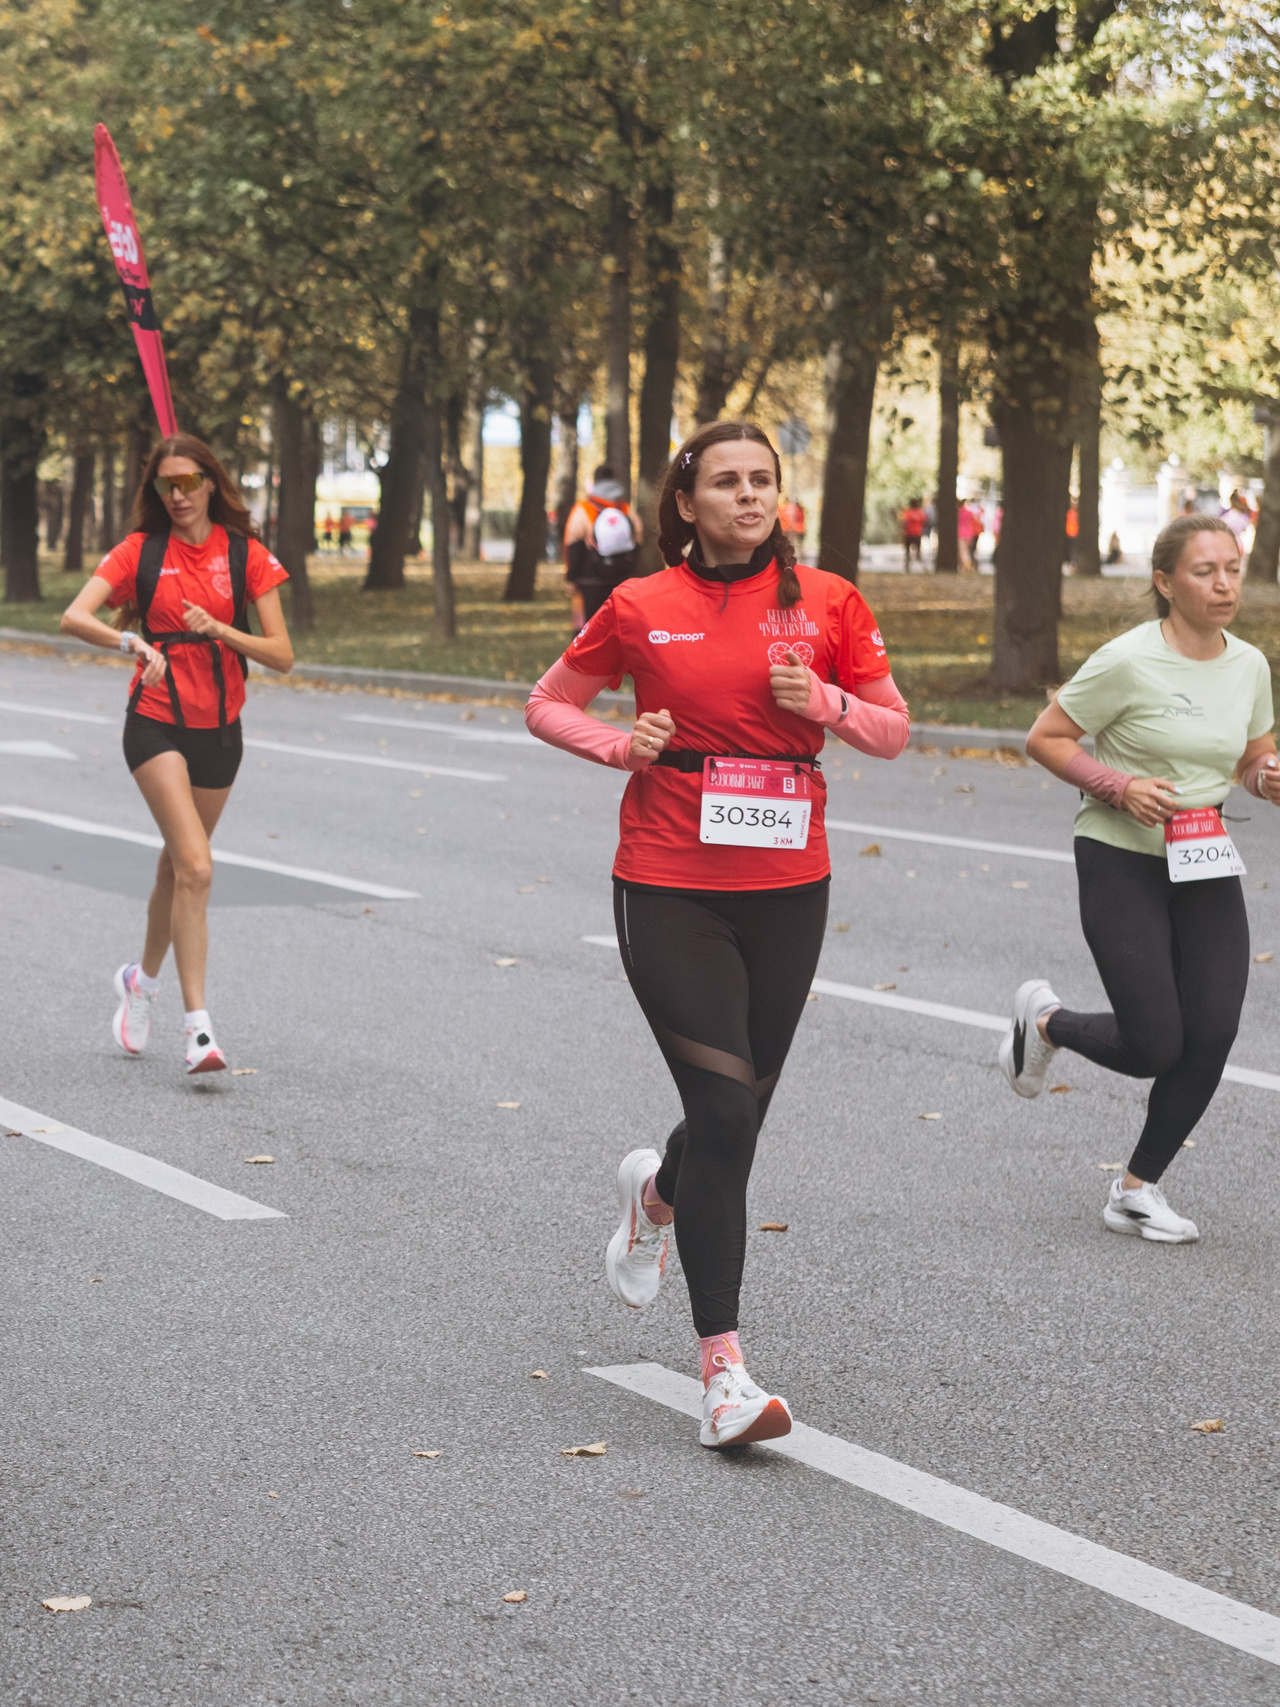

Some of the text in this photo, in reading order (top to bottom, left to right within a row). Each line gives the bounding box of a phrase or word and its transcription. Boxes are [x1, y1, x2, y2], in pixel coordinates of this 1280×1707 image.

[758, 621, 820, 637] ЧУВСТВУЕШЬ
[710, 772, 745, 789] РОЗОВЫЙ
[709, 804, 793, 829] 30384
[773, 836, 779, 845] 3
